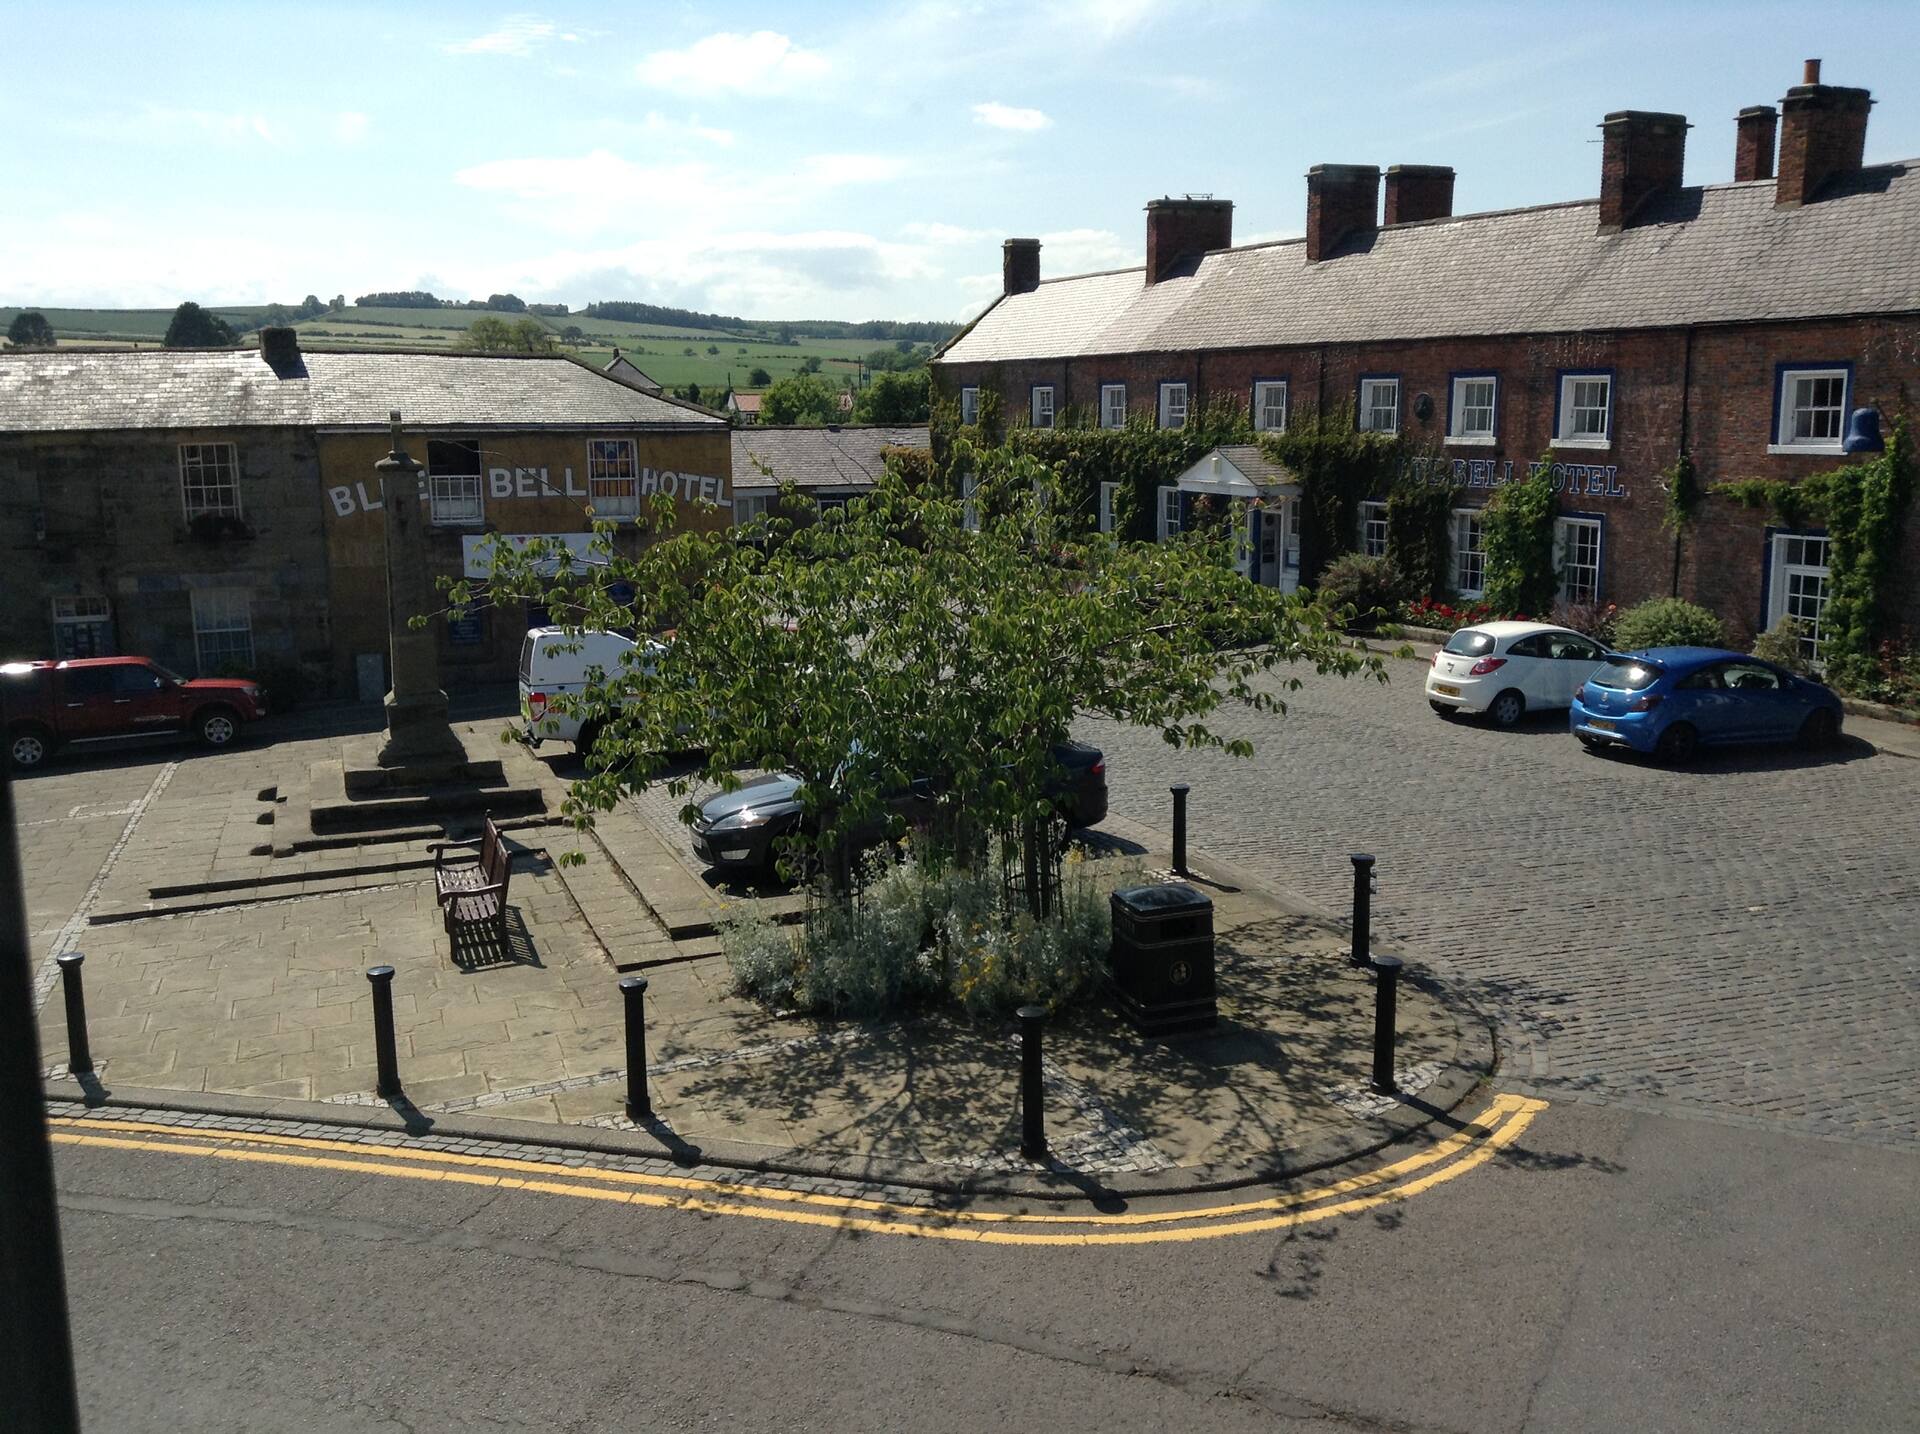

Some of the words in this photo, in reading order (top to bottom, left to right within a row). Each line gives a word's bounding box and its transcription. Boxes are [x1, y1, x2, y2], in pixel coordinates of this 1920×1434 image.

[328, 471, 429, 517] BLE
[489, 468, 588, 498] BELL
[640, 468, 733, 508] HOTEL
[1453, 458, 1521, 489] BELL
